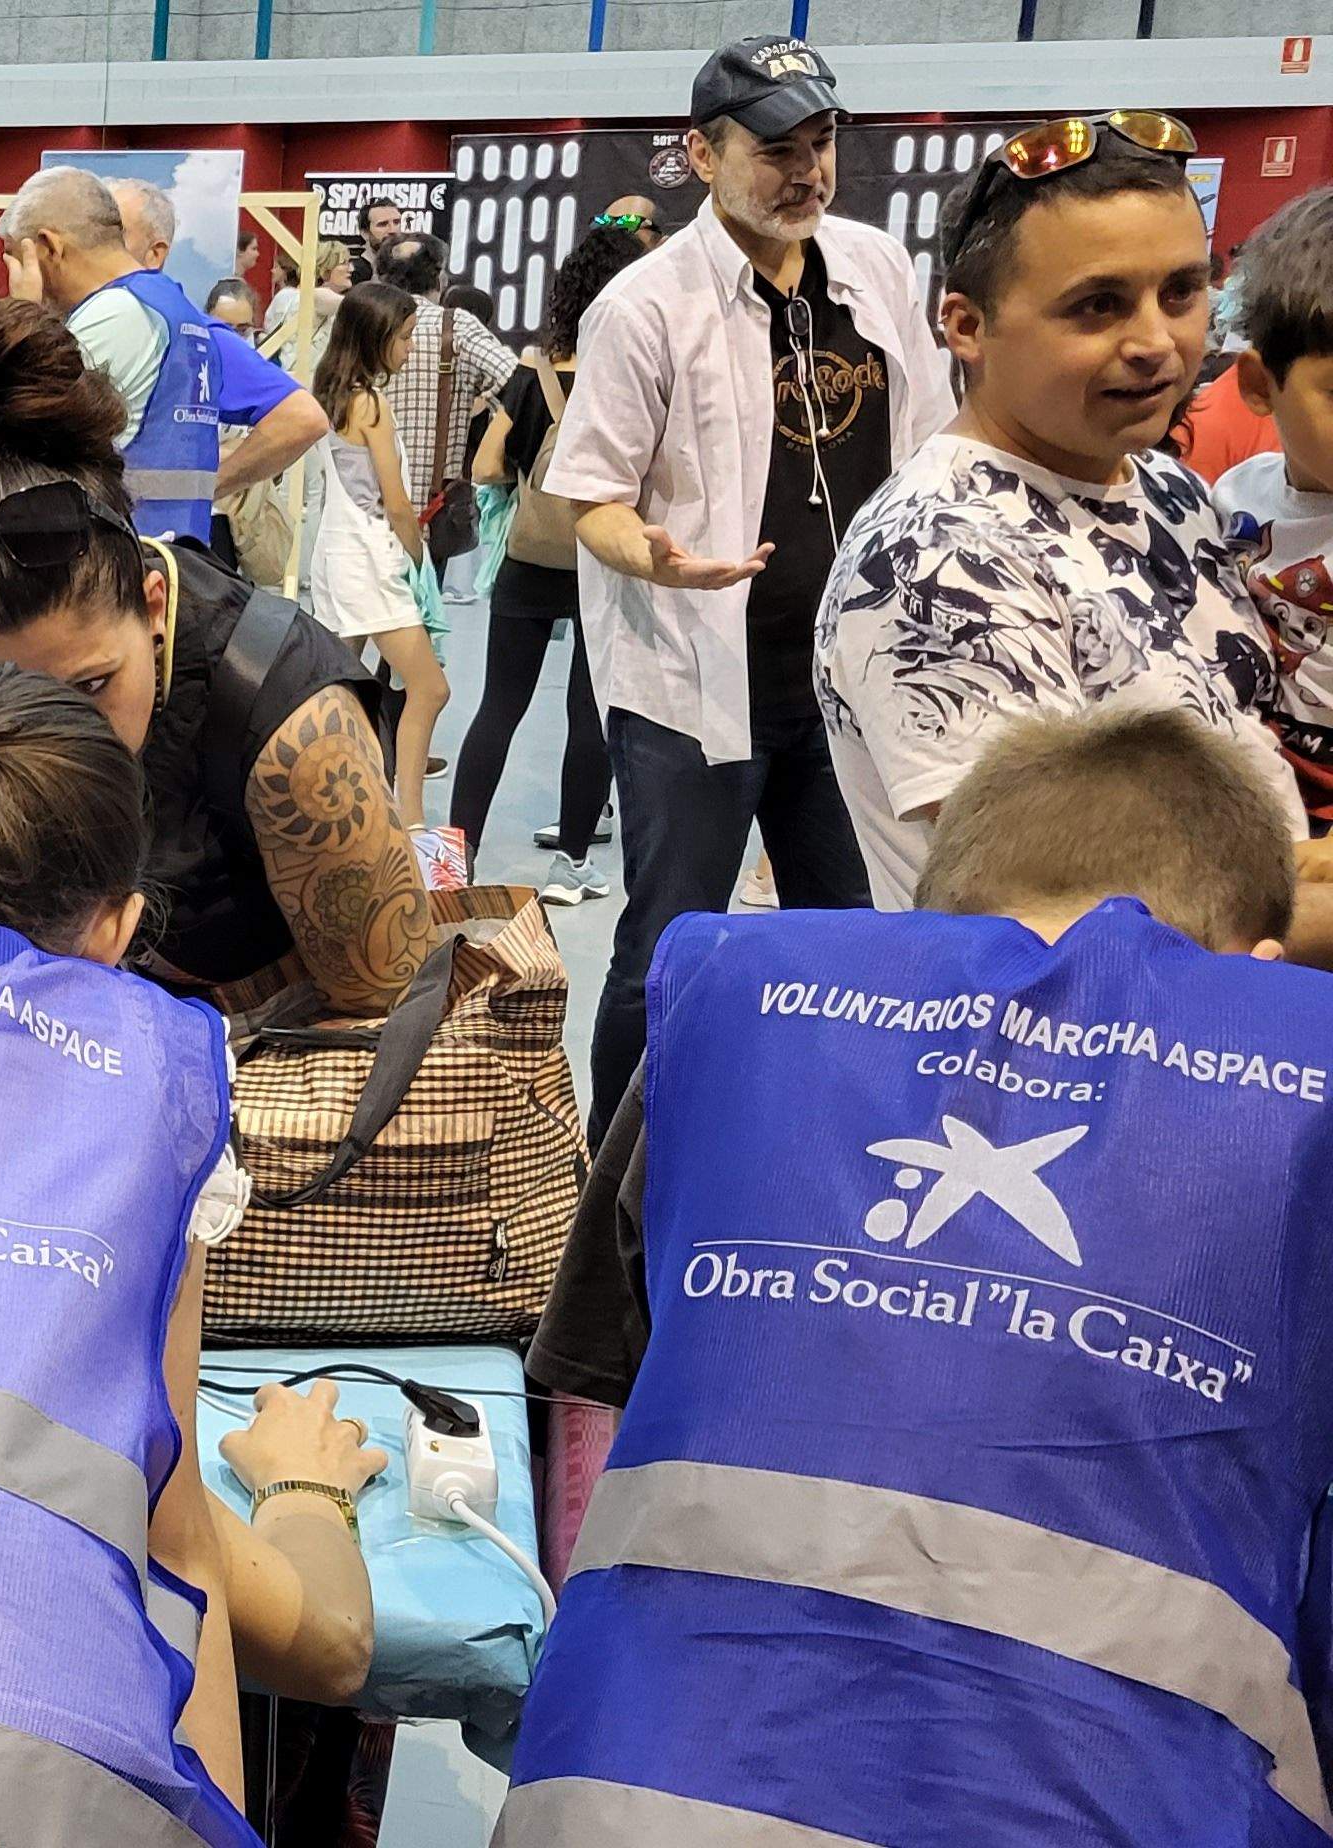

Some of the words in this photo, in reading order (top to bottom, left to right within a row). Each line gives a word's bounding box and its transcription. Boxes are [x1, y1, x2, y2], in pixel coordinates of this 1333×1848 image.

[318, 209, 434, 236] GARON
[327, 182, 429, 209] SPANISH
[17, 1003, 123, 1077] ASPACE
[760, 981, 995, 1033] VOLUNTARIOS
[1000, 1000, 1159, 1062] MARCHA
[1162, 1040, 1327, 1103] ASPACE
[915, 1050, 1106, 1104] Colabora:
[683, 1252, 795, 1301] Obra
[810, 1258, 979, 1328] Social
